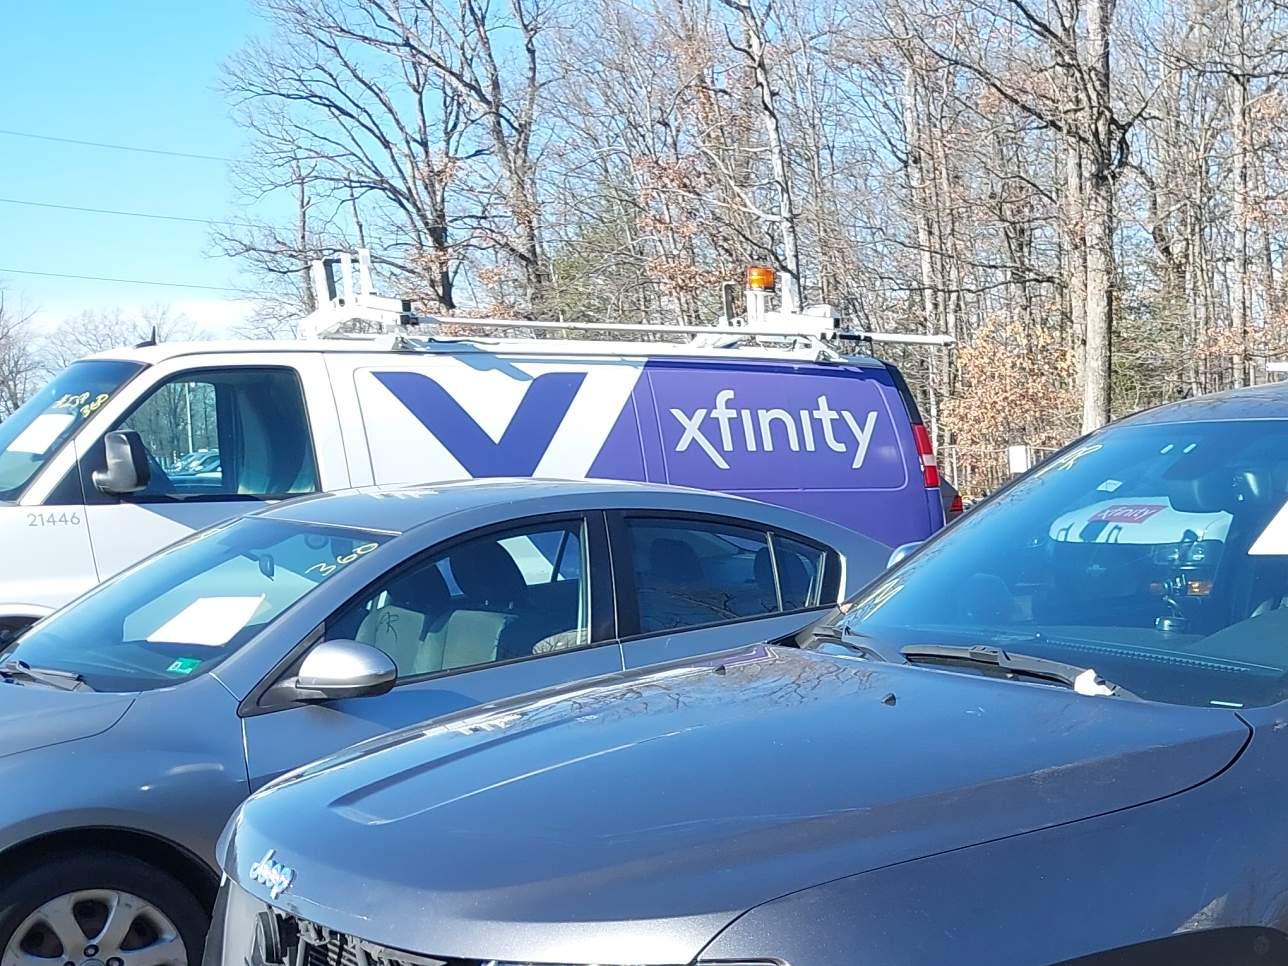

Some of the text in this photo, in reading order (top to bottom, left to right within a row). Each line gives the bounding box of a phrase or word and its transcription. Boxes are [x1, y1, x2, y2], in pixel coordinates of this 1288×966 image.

[669, 389, 878, 469] xfinity
[26, 511, 81, 527] 21446
[304, 542, 379, 577] 360
